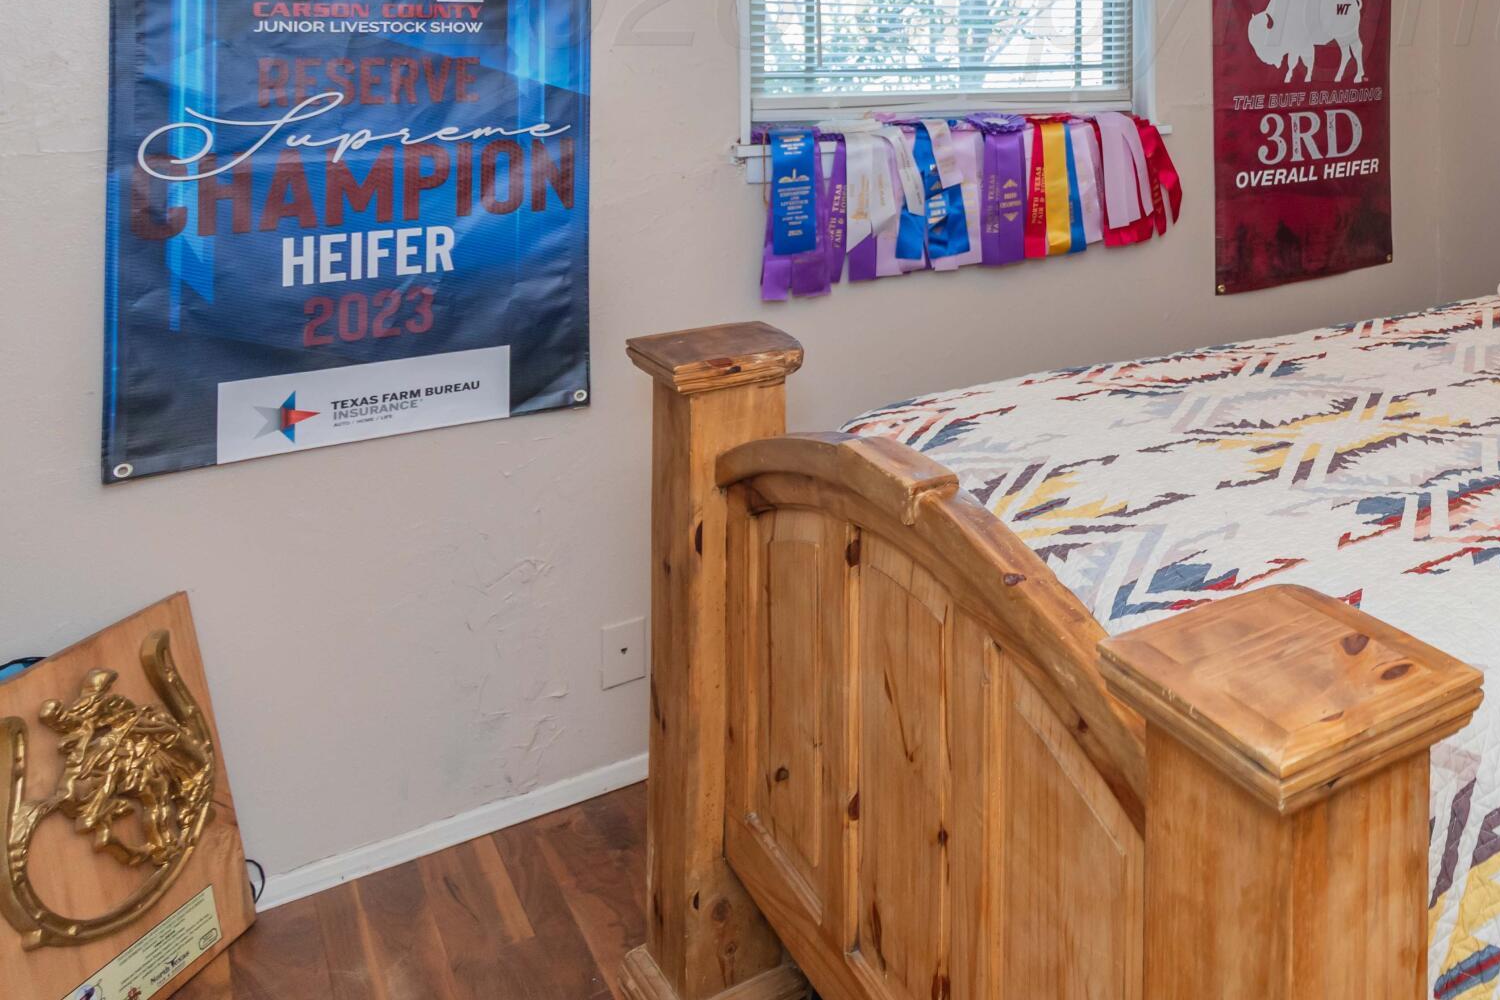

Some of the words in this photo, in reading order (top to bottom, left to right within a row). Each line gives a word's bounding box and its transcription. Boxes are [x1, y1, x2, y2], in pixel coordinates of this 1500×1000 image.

[252, 1, 370, 19] CARSON
[381, 2, 482, 19] COUNTY
[1336, 3, 1352, 16] WT
[253, 20, 325, 34] JUNIOR
[330, 20, 426, 34] LIVESTOCK
[430, 21, 484, 34] SHOW
[257, 56, 481, 108] RESERVE
[1232, 94, 1265, 111] THE
[1268, 92, 1306, 109] BUFF
[1309, 86, 1383, 105] BRANDING
[137, 91, 571, 181] Supreme
[1257, 108, 1363, 165] 3RD
[1235, 165, 1318, 189] OVERALL
[1323, 158, 1380, 179] HEIFER
[131, 136, 575, 243] CHAMPION
[281, 225, 454, 288] HEIFER
[303, 286, 434, 348] 2023
[331, 395, 378, 410] TEXAS
[382, 389, 421, 403] FARM
[425, 380, 480, 397] BUREAU
[333, 400, 418, 421] INSURANCE
